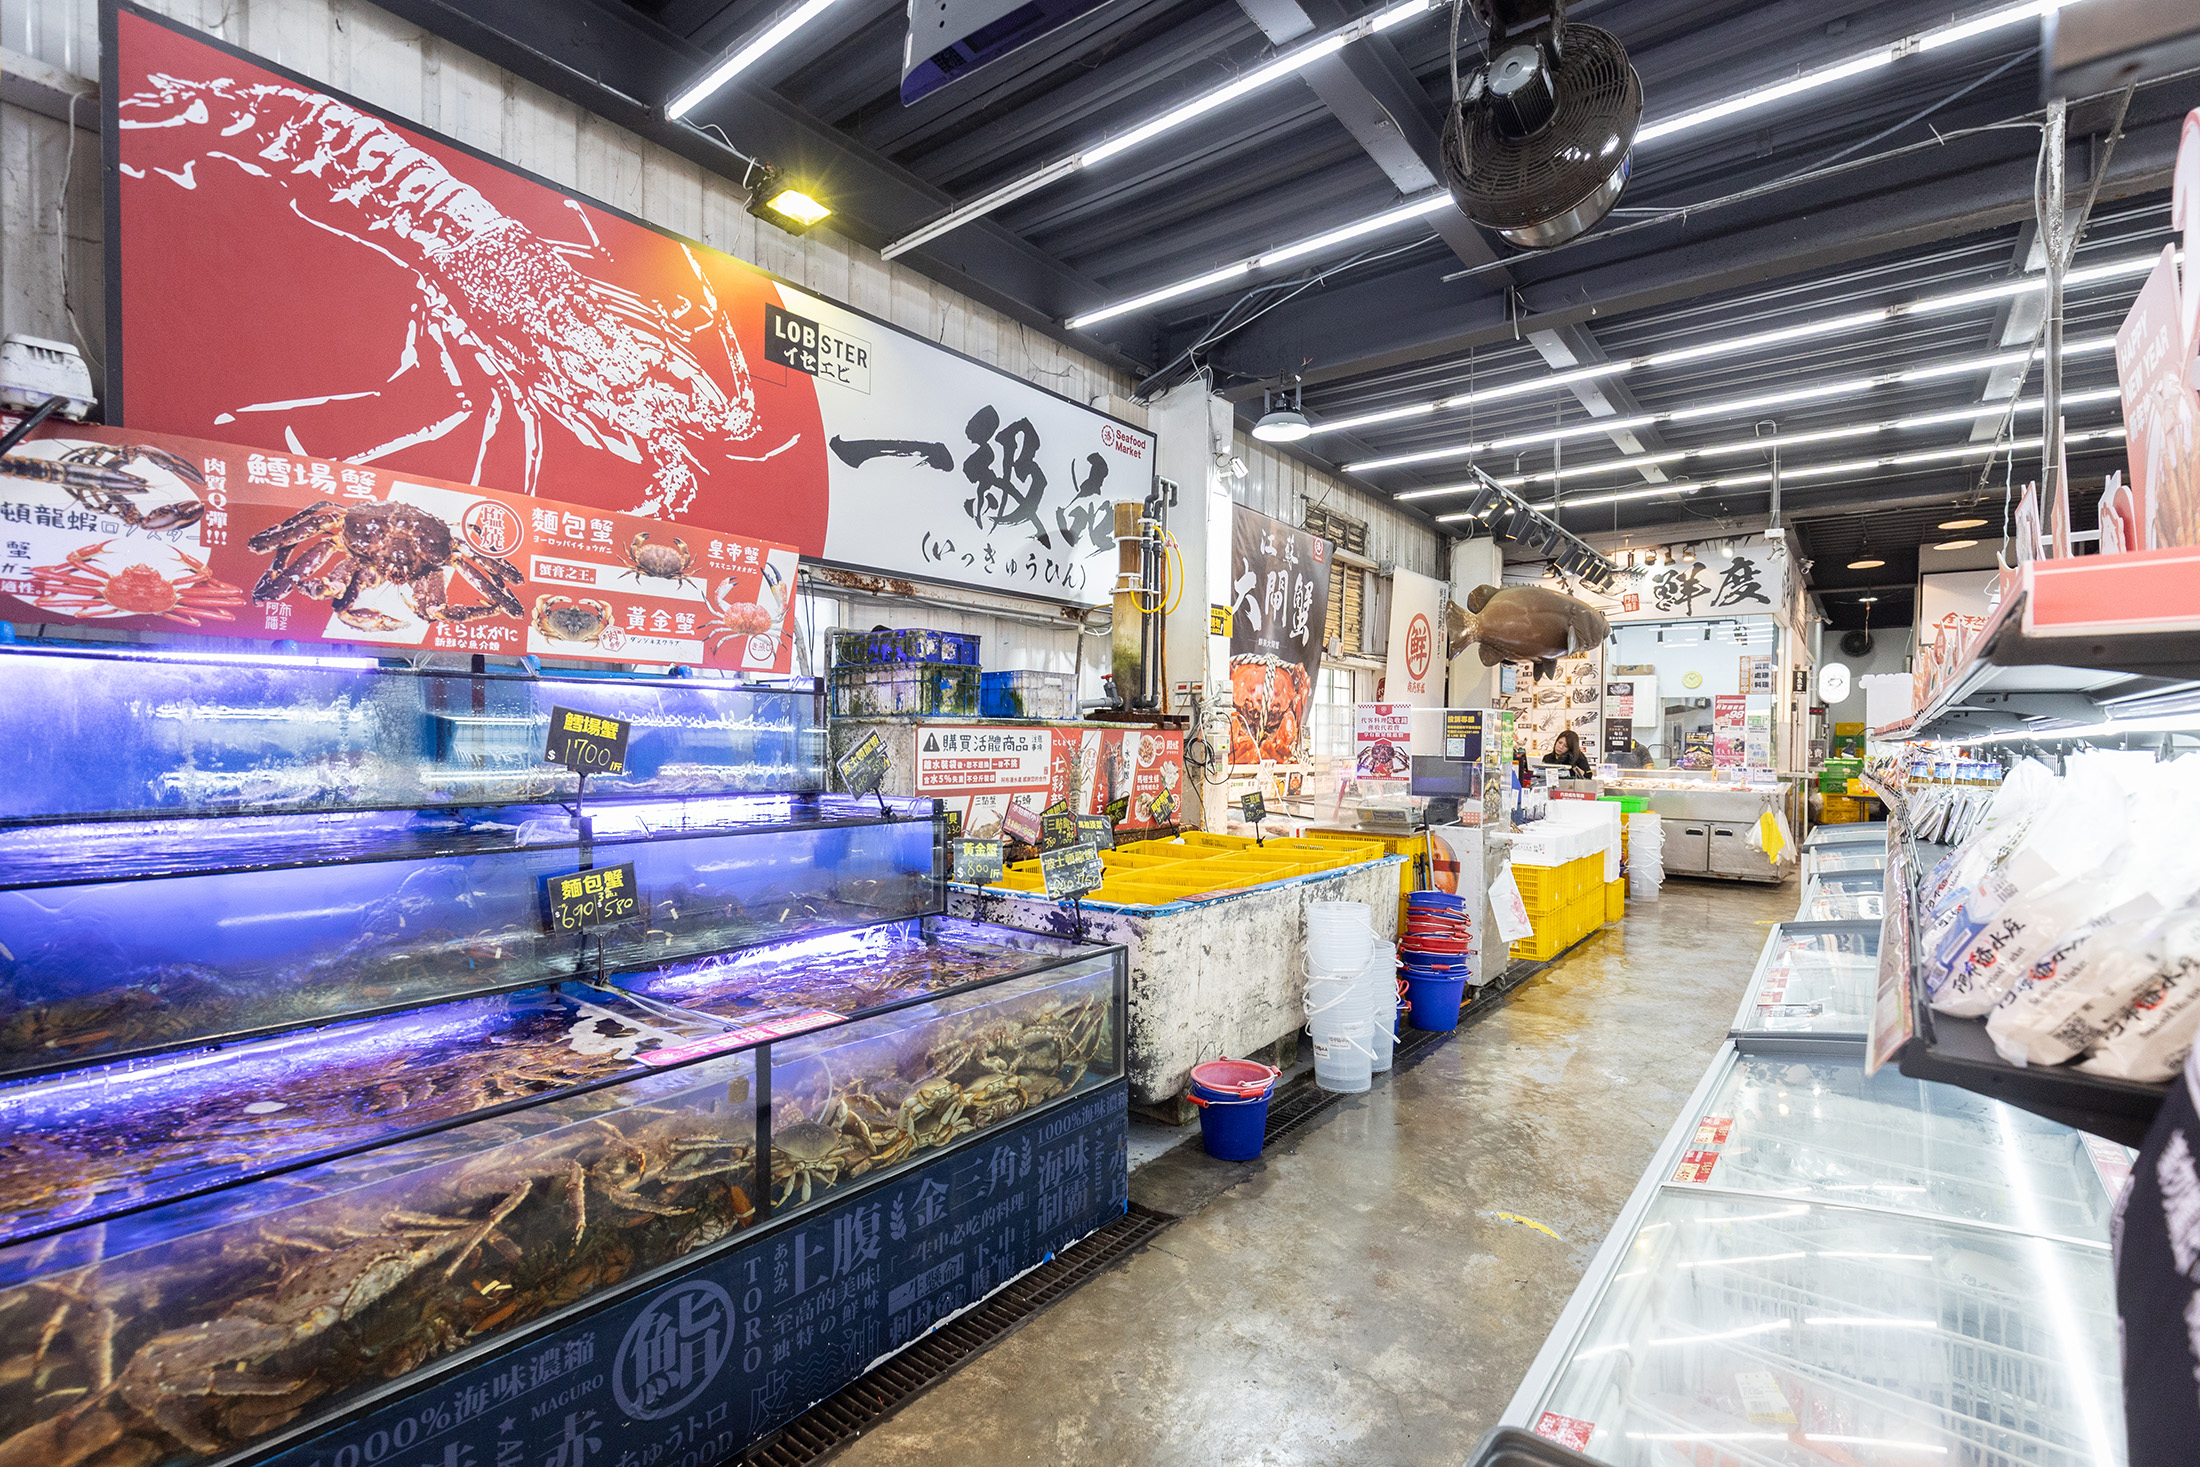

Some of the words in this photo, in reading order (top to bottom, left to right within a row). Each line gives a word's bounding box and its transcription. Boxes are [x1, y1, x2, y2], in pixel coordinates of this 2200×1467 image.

[775, 314, 868, 369] LOBSTER
[2121, 309, 2148, 373] HAPPY
[783, 346, 851, 384] イセエビ
[2124, 361, 2144, 408] NEW
[2143, 324, 2170, 378] YEAR
[1115, 429, 1146, 450] Seafood
[1115, 440, 1142, 459] Market
[246, 453, 378, 502] 鱈場蟹
[829, 404, 1117, 559] 一級品
[531, 506, 614, 545] 麵包蟹
[707, 538, 760, 566] 皇帝蟹
[538, 562, 596, 583] 蟹膏之王。
[1652, 556, 1772, 617] 鮮度
[1231, 555, 1315, 648] 大閘蟹
[435, 621, 519, 643] たらばがに
[562, 711, 620, 741] 鱈場蟹
[942, 733, 1029, 753] 購買活體商品
[560, 868, 625, 901] 麵包蟹
[604, 897, 634, 918] 580
[742, 1255, 763, 1375] TORO
[306, 1331, 597, 1467] 000%海味濃縮
[529, 1373, 605, 1423] MAGURO
